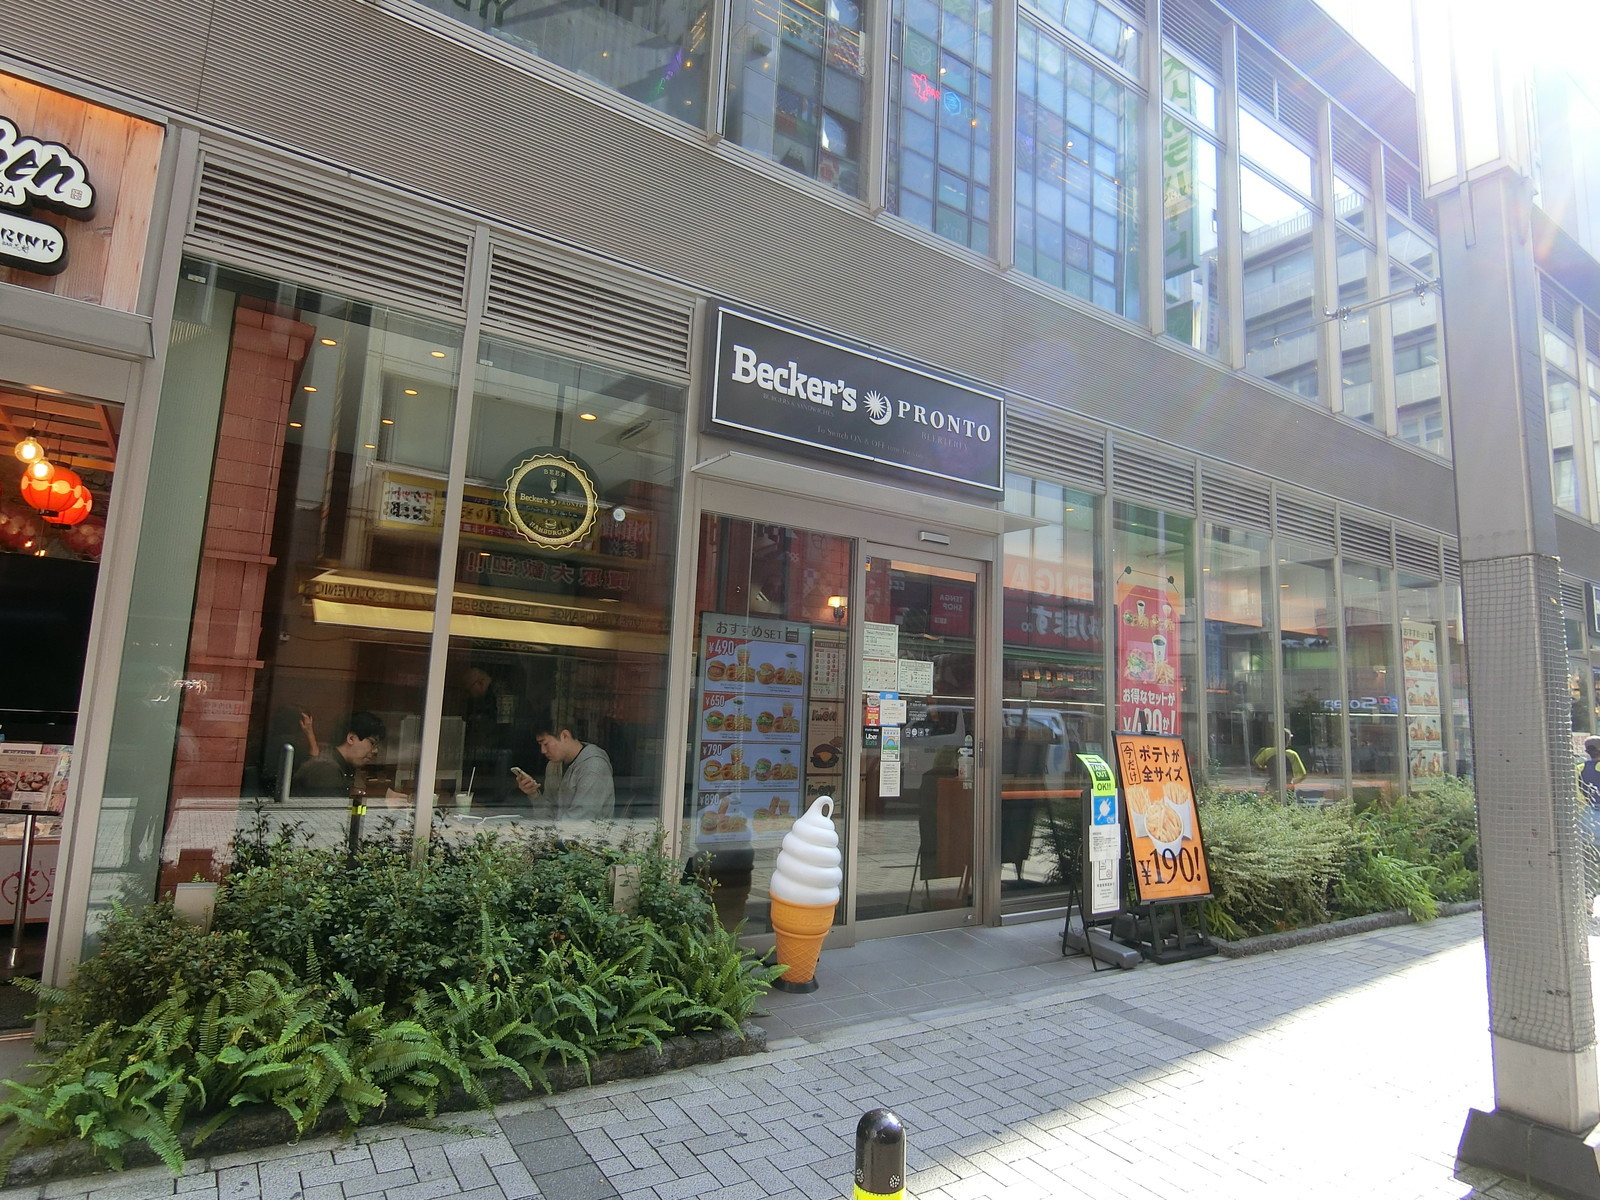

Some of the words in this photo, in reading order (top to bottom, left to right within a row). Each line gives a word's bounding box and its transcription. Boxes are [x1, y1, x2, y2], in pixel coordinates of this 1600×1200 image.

[0, 129, 75, 194] en
[731, 344, 857, 412] Becker's
[897, 399, 992, 442] PRONTO
[543, 469, 566, 478] BEER
[520, 493, 548, 504] Becker's
[557, 500, 584, 508] PRONTO
[529, 521, 571, 536] HAMBURGER
[708, 639, 735, 656] ¥490
[705, 695, 725, 707] ¥650
[1123, 688, 1176, 706] お得なセットが
[702, 743, 723, 756] ¥790
[1139, 744, 1180, 762] ポテトが
[1123, 744, 1138, 782] 今だけ
[1142, 765, 1183, 783] 全サイズ
[700, 794, 720, 806] ¥890
[1139, 846, 1201, 885] ¥190!
